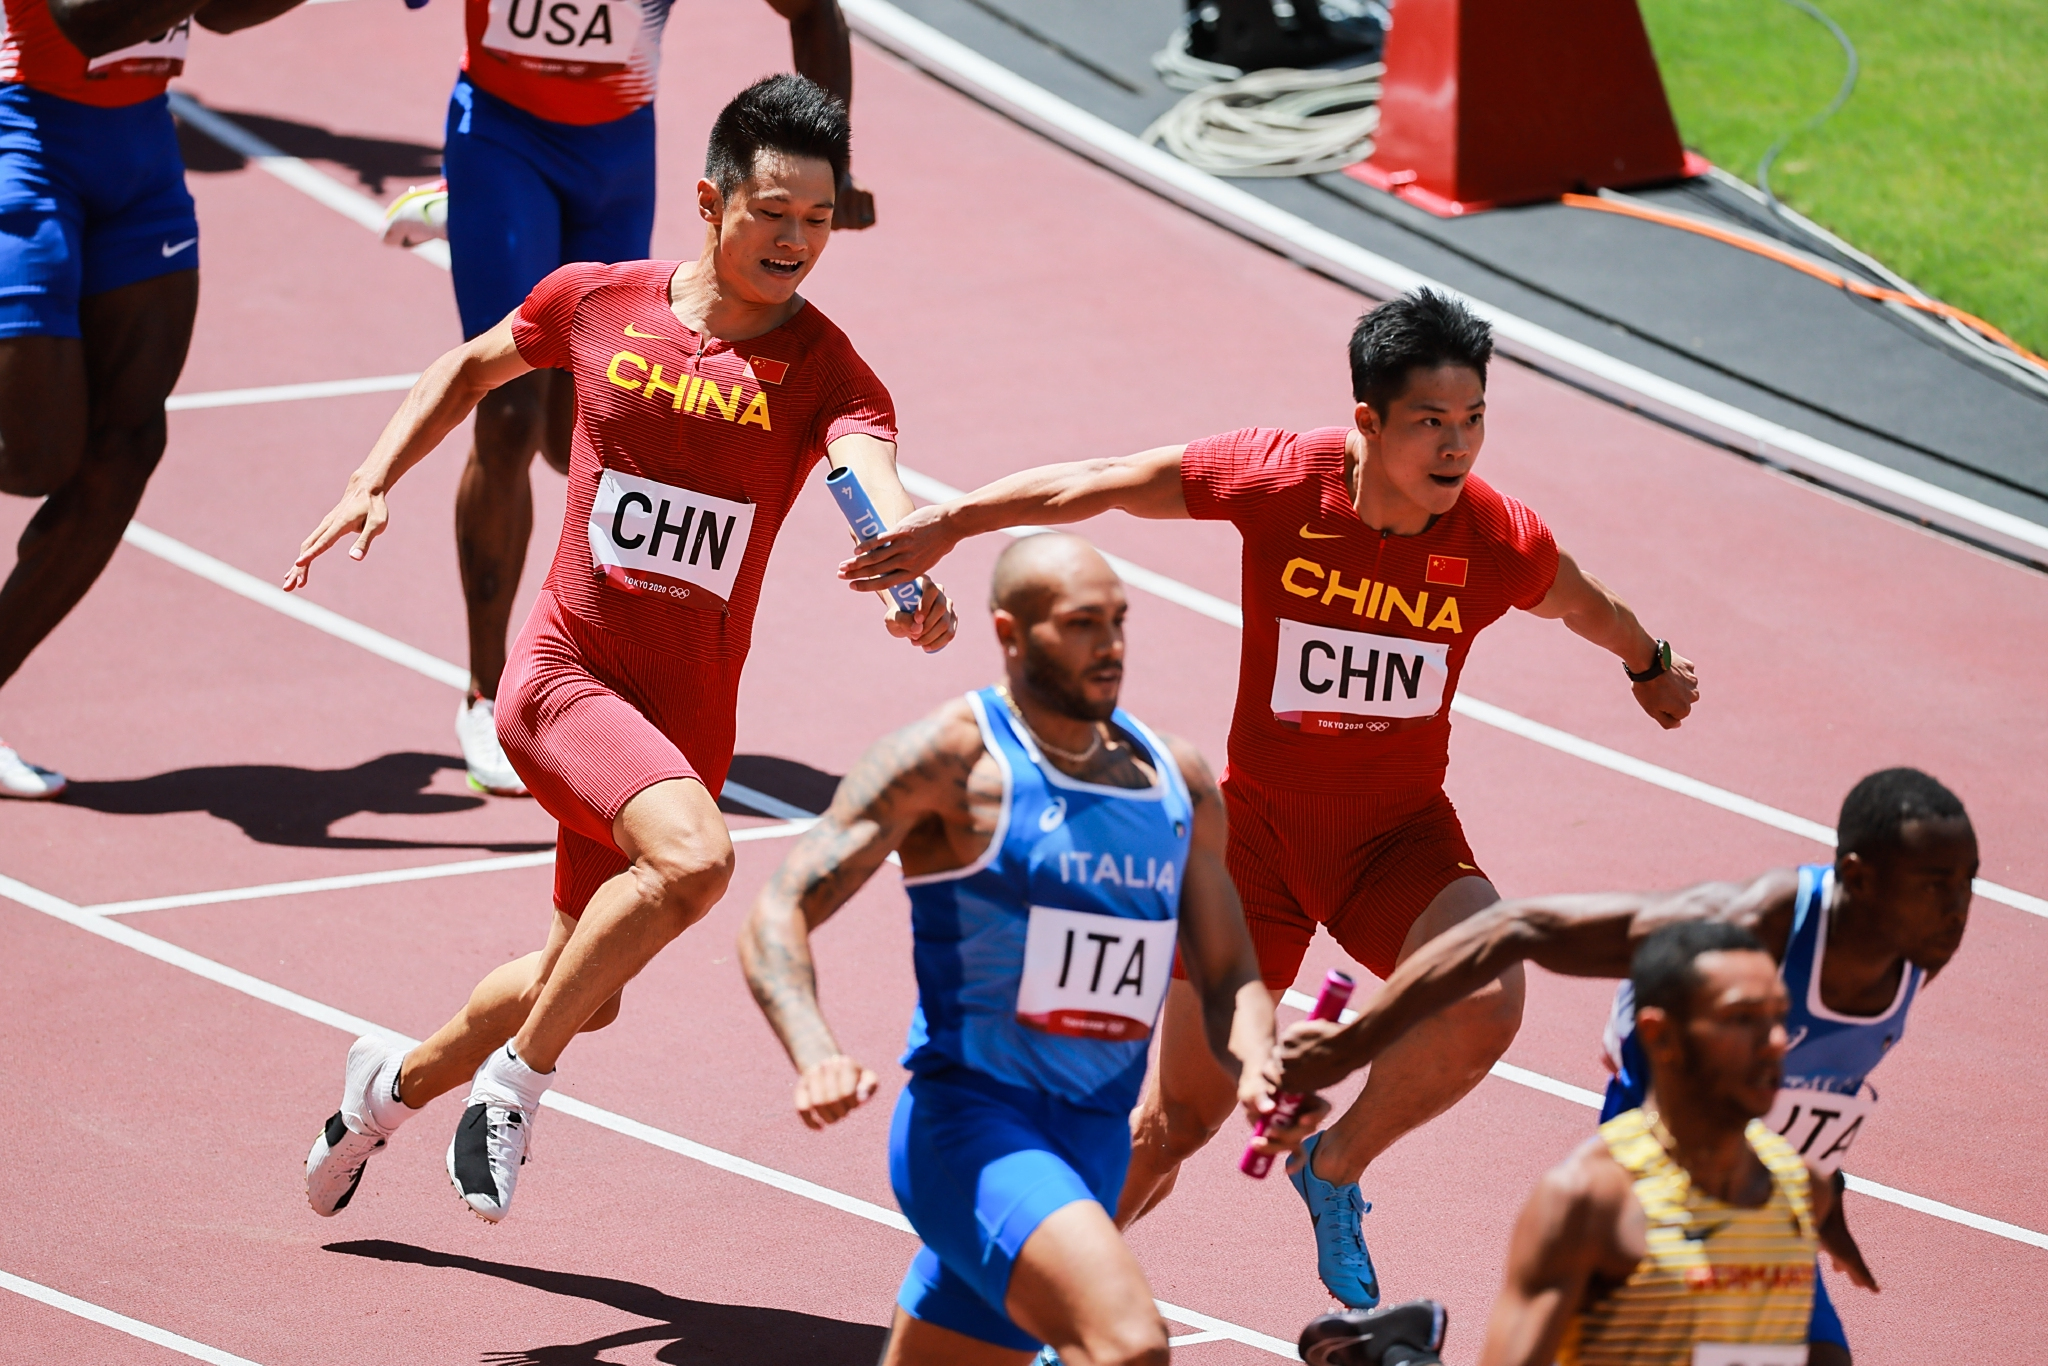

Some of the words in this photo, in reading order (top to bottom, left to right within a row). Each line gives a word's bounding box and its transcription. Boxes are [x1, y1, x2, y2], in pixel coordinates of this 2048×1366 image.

[507, 0, 612, 47] USA
[606, 350, 772, 432] CHINA
[842, 486, 852, 499] 4
[611, 491, 737, 571] CHN
[624, 575, 648, 590] TOKYO
[648, 582, 667, 594] 2020
[1281, 557, 1463, 634] CHINA
[1300, 640, 1424, 702] CHN
[1317, 719, 1344, 731] TOKYO
[1344, 722, 1364, 731] 2020
[1059, 851, 1176, 896] ITALIA
[1057, 929, 1145, 997] ITA
[1778, 1104, 1865, 1161] ITA
